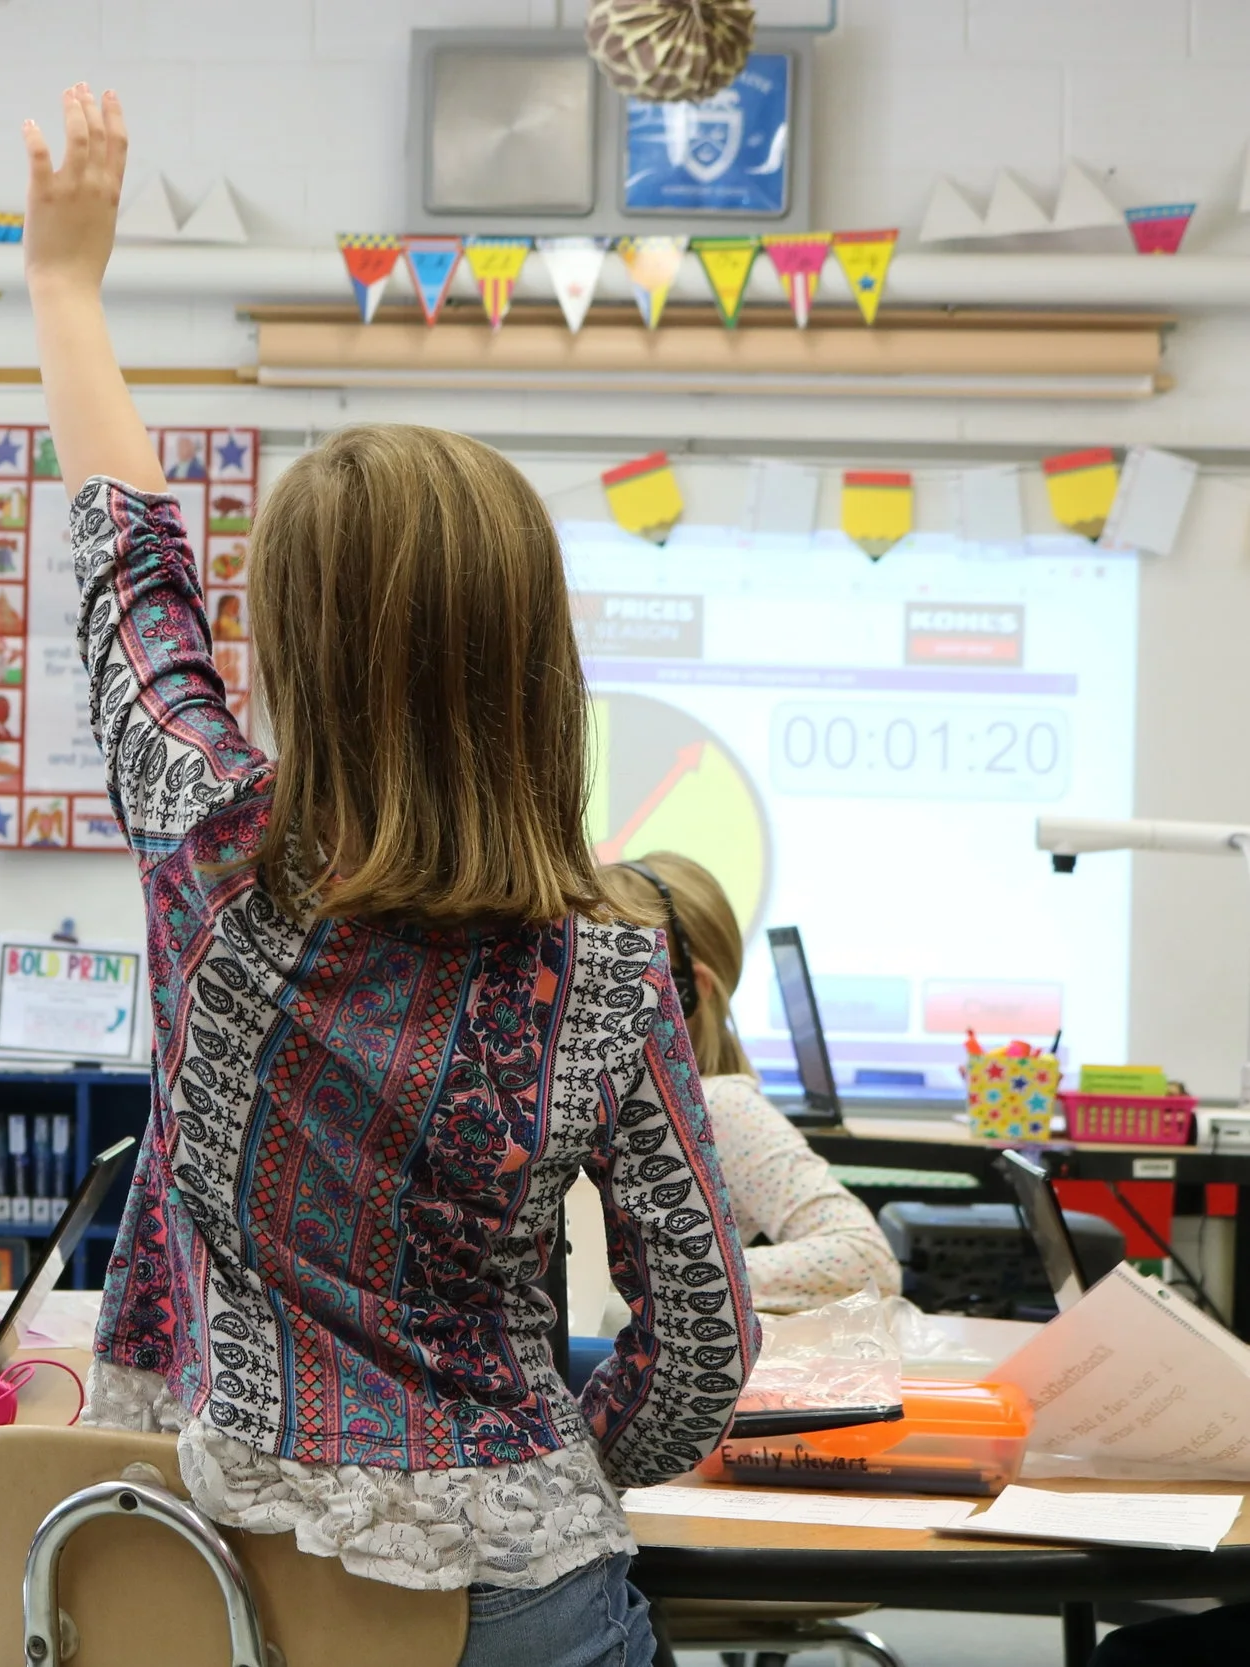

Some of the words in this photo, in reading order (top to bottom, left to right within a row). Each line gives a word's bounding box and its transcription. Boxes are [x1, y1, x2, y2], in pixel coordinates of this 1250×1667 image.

[604, 597, 695, 623] PRICES
[783, 715, 1060, 776] 00:01:20
[7, 947, 61, 977] BOLD
[66, 953, 135, 985] PRINT
[720, 1444, 783, 1472] Emily
[790, 1443, 869, 1472] Stewart
